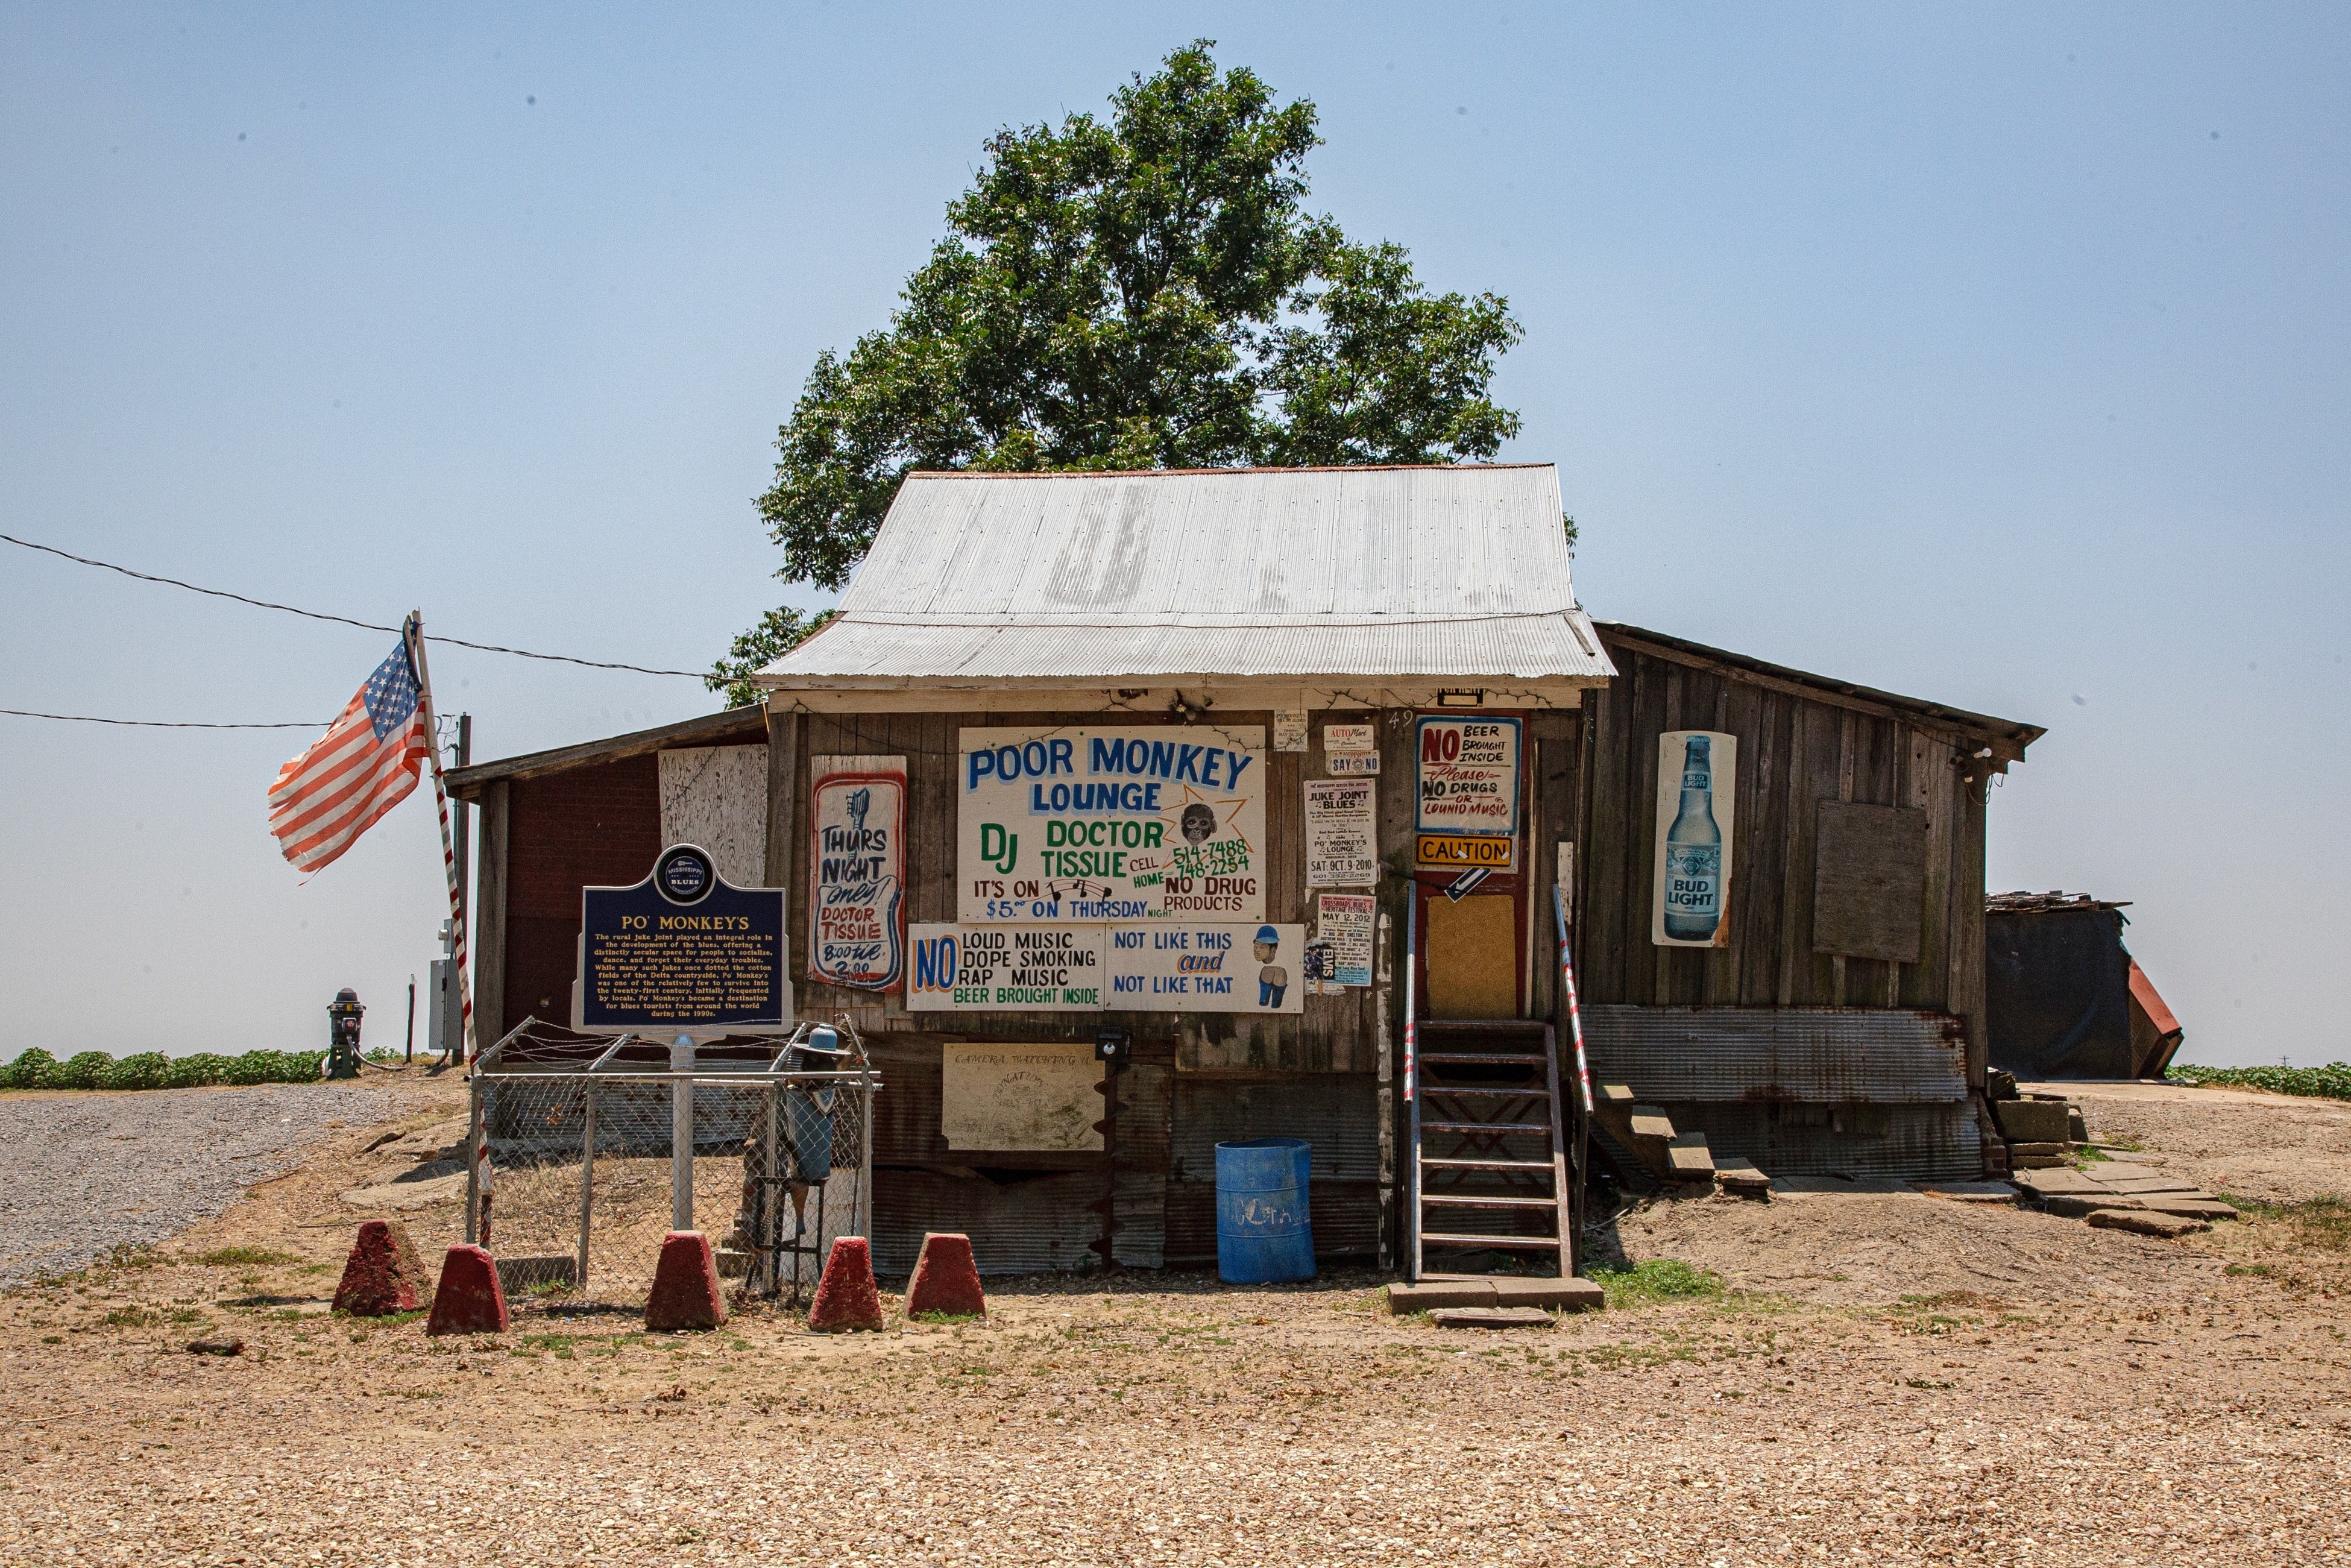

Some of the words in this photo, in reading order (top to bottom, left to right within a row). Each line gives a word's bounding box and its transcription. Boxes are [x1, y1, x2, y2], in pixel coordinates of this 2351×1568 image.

[1331, 729, 1350, 738] AUTO
[1350, 728, 1367, 737] Mart
[1464, 725, 1499, 737] BEER
[1422, 729, 1459, 762] NO
[1462, 740, 1507, 751] BROUGHT
[968, 738, 1074, 792] POOR
[1090, 737, 1253, 792] MONKEY
[1333, 759, 1351, 771] SAY
[1365, 758, 1377, 770] NO
[1459, 753, 1503, 762] INSIDE
[1430, 765, 1490, 781] Please
[1309, 792, 1335, 801] JUKE
[1339, 791, 1369, 800] JOINT
[1422, 781, 1446, 797] NO
[1450, 782, 1497, 793] DRUGS
[1031, 782, 1162, 814] LOUNGE
[1323, 800, 1356, 809] BLUES
[1455, 795, 1473, 804] OR
[1470, 803, 1508, 816] MUSIC
[822, 825, 887, 853] THURS
[981, 822, 1018, 875] DJ
[1046, 820, 1164, 849] DOCTOR
[1130, 856, 1159, 872] CELL
[1173, 839, 1247, 864] 514-7488
[1423, 841, 1509, 860] CAUTION
[822, 857, 886, 884] NIGHT
[1040, 851, 1127, 877] TISSUE
[1177, 855, 1249, 881] 748-2254
[1330, 860, 1346, 871] OCT.
[975, 880, 1005, 898] IT'S
[1013, 880, 1039, 897] ON
[1165, 877, 1193, 894] NO
[1204, 877, 1257, 896] DRUG
[1674, 880, 1709, 892] BUD
[1164, 896, 1243, 911] PRODUCTS
[1668, 892, 1713, 905] LIGHT
[821, 907, 875, 922] DOCTOR
[1032, 901, 1058, 918] ON
[1069, 901, 1148, 918] THURSDAY
[622, 916, 650, 930] PO'
[659, 916, 750, 930] MONKEY'S
[820, 922, 881, 940] TISSUE
[1115, 932, 1145, 949] NOT
[1154, 932, 1188, 950] LIKE
[1196, 932, 1232, 950] THIS
[824, 945, 851, 962] 8:00
[963, 951, 1012, 968] DOPE
[1020, 950, 1095, 967] SMOKING
[835, 961, 869, 975] 2:00
[911, 935, 960, 993] NO
[963, 932, 1006, 949] LOUD
[1015, 933, 1074, 949] MUSIC
[1177, 951, 1225, 974] and
[1322, 949, 1334, 978] ELVIS
[958, 969, 993, 986] RAP
[1012, 969, 1068, 986] MUSIC
[1114, 975, 1145, 993] NOT
[1154, 976, 1188, 993] LIKE
[1195, 977, 1233, 993] THAT
[954, 987, 989, 1004] BEER
[996, 987, 1059, 1004] BROUGHT
[1063, 987, 1098, 1004] INSIDE
